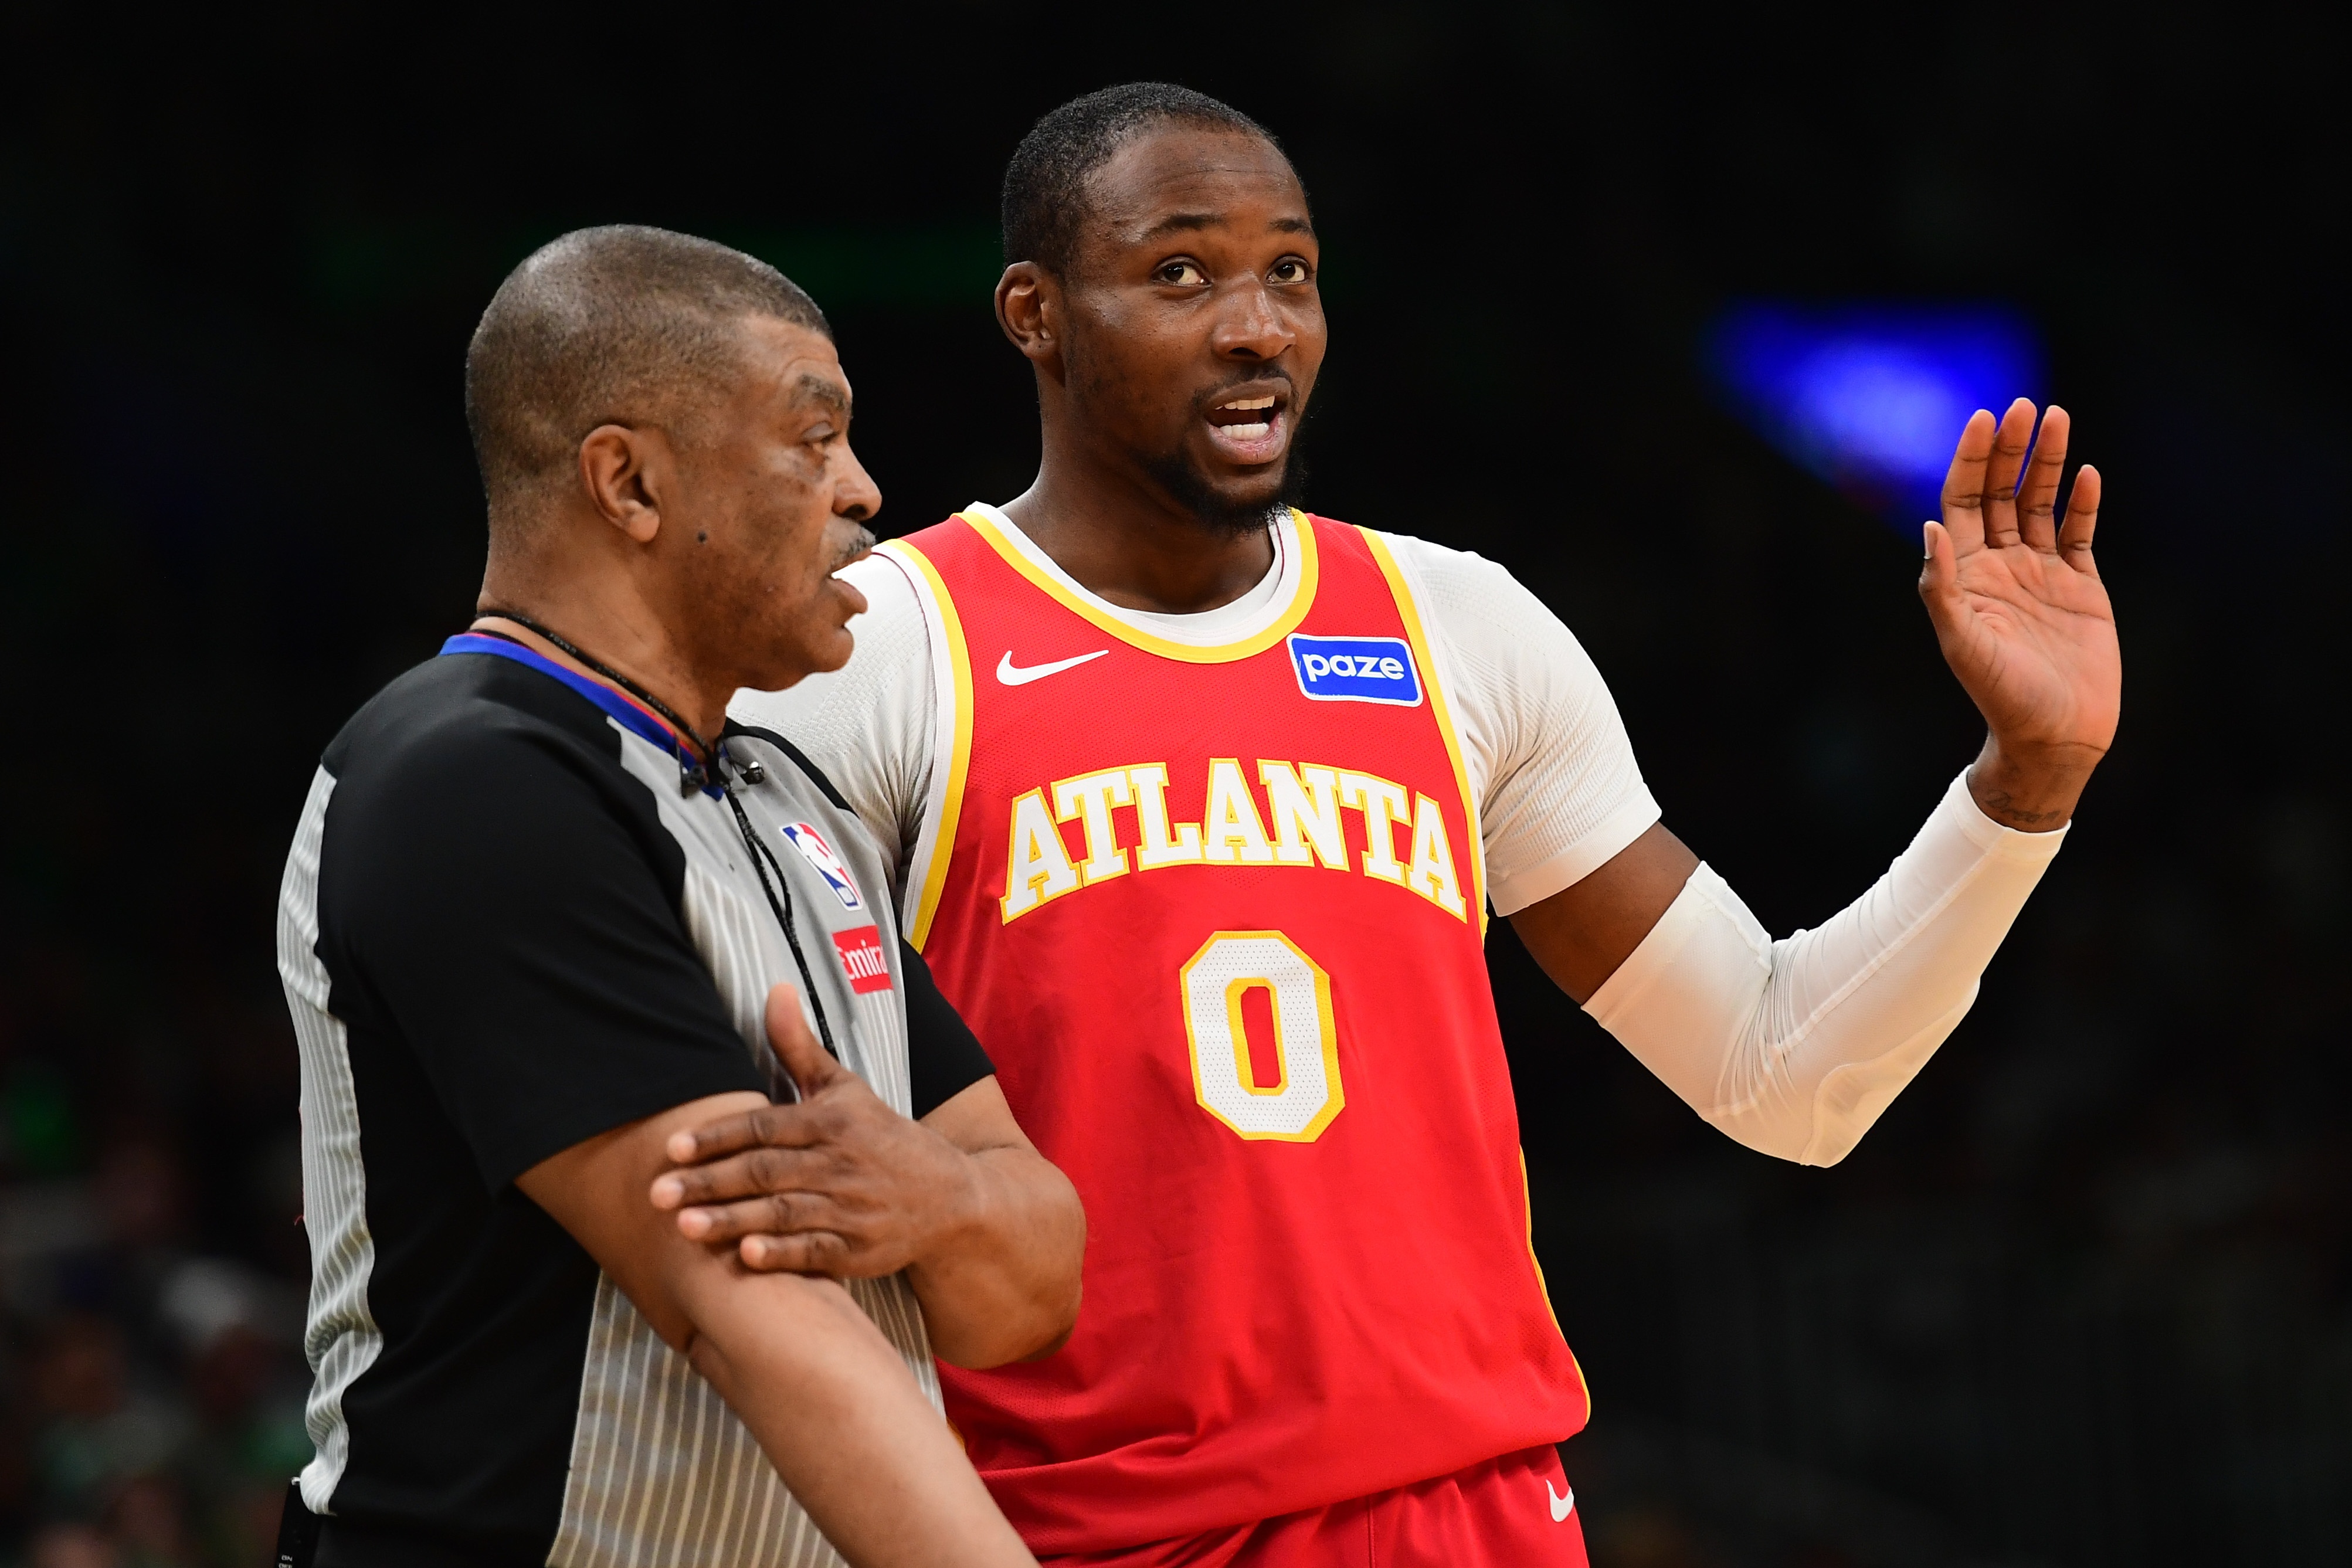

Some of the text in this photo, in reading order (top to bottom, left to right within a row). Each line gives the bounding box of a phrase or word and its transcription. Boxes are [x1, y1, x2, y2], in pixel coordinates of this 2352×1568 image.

[1302, 653, 1404, 682] paze
[999, 757, 1468, 925] ATLANTA
[1179, 930, 1346, 1143] 0
